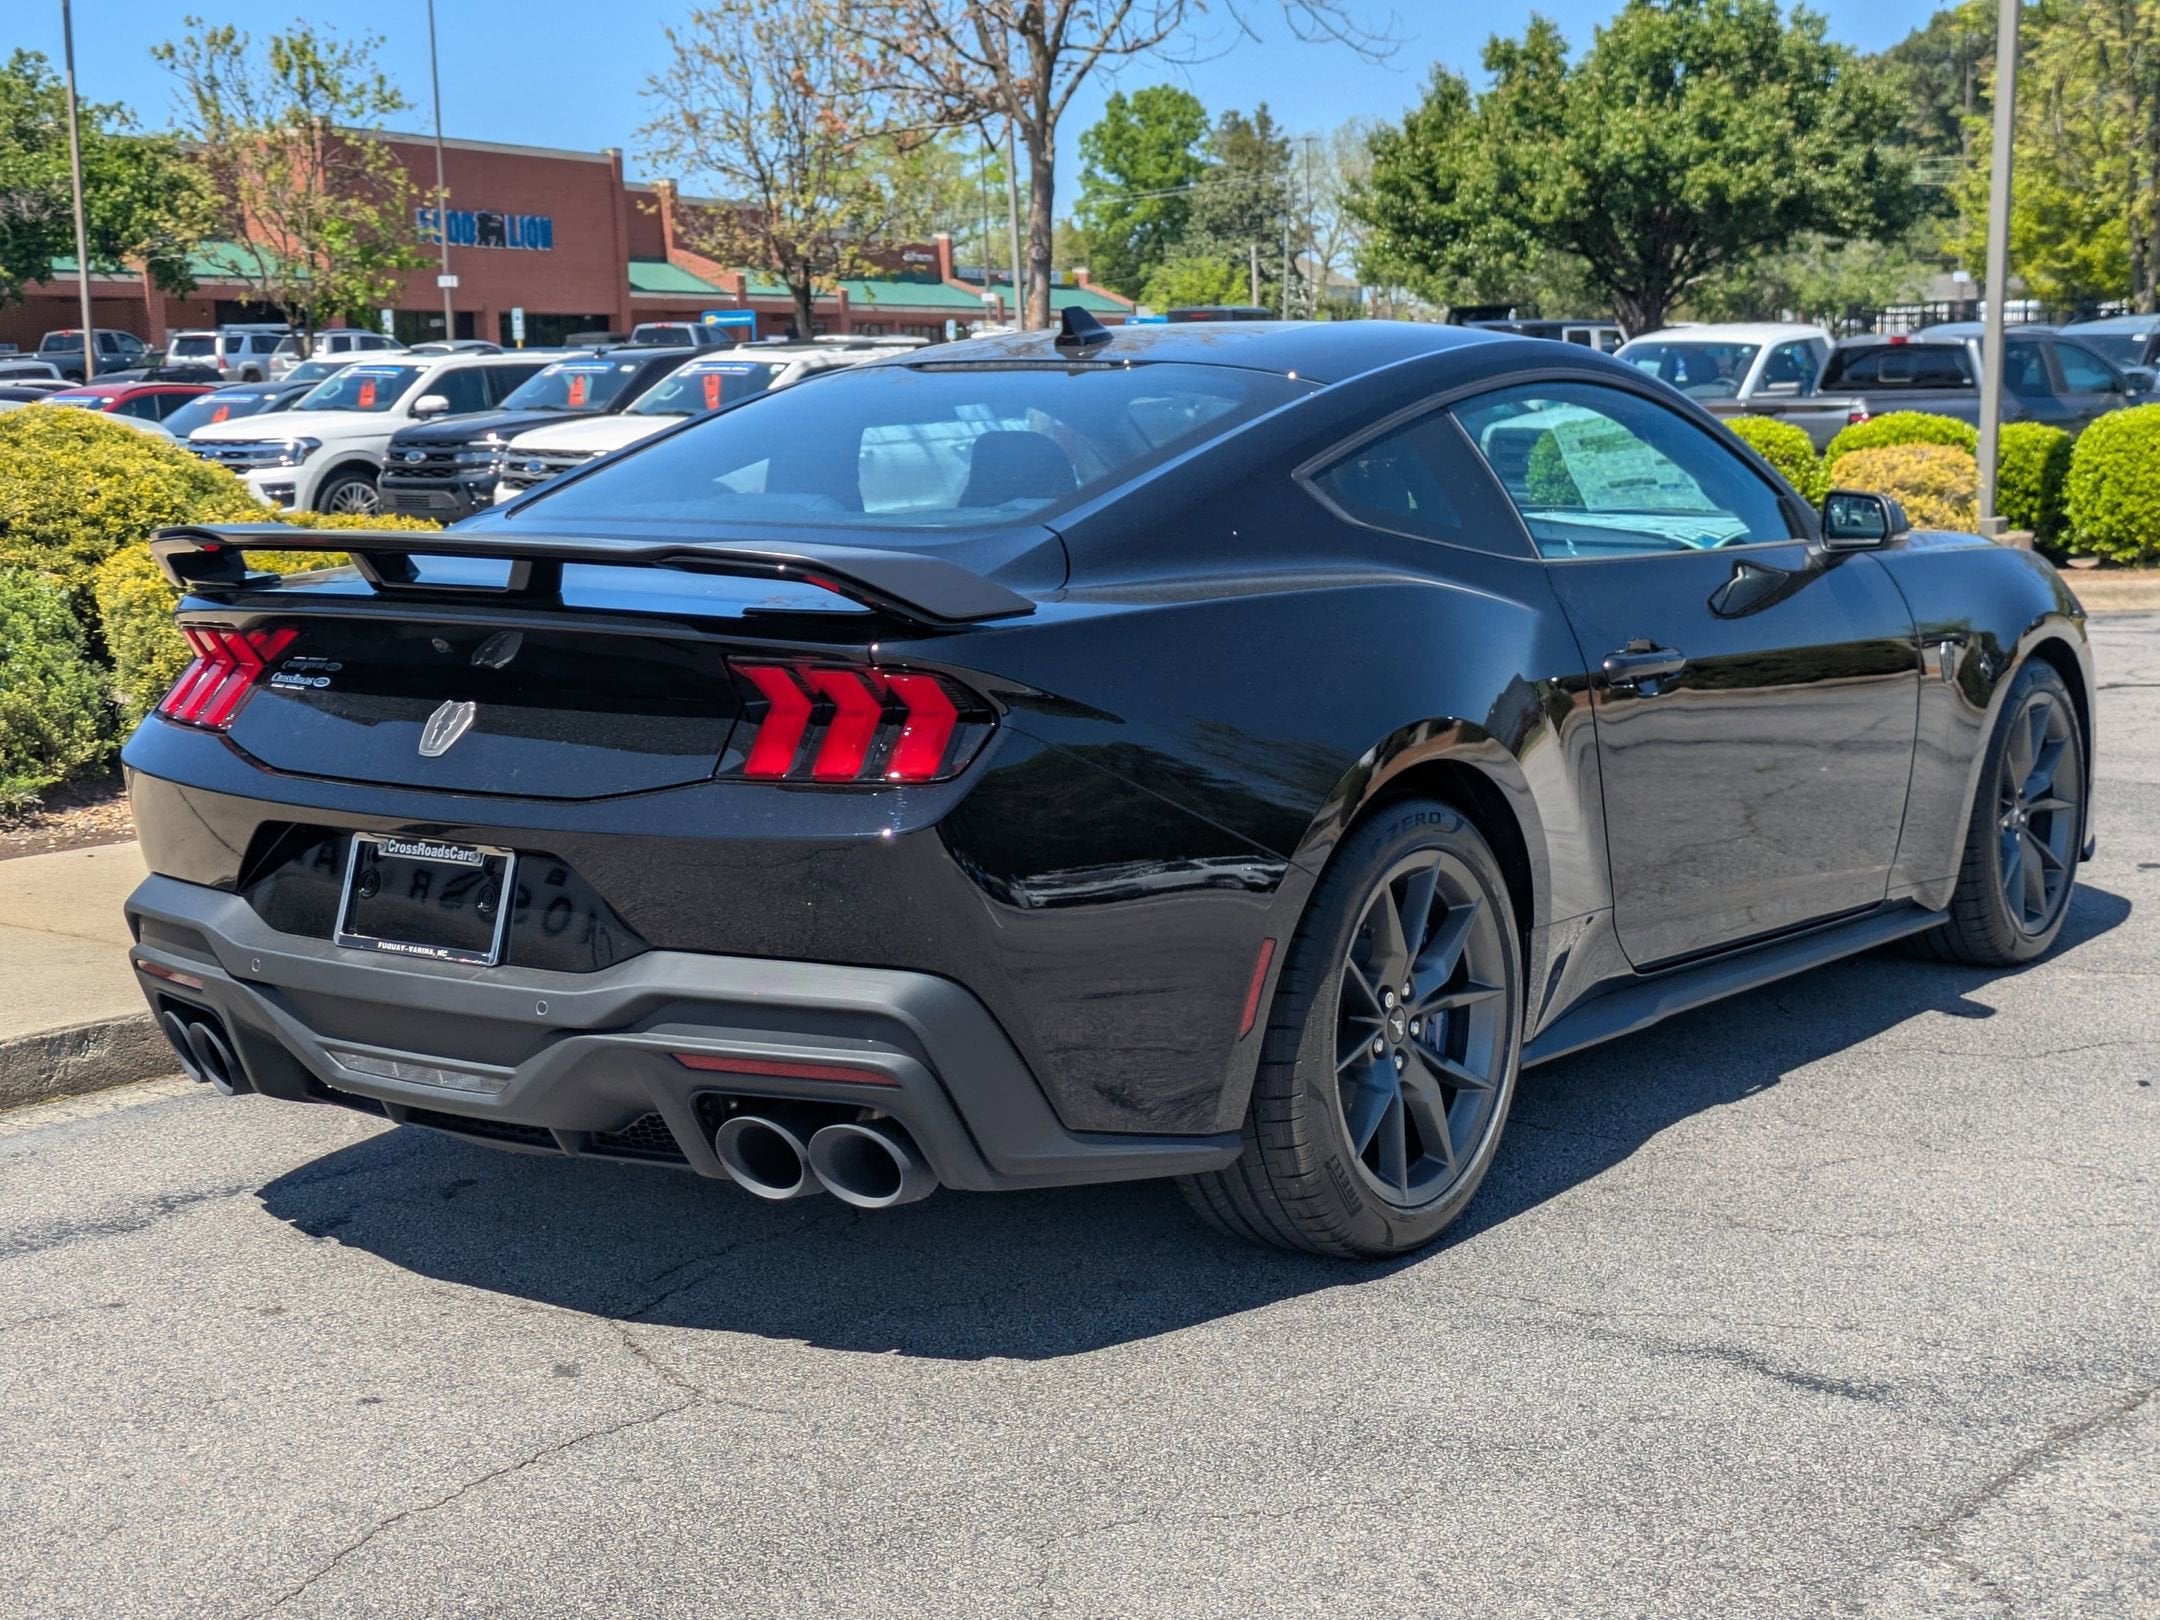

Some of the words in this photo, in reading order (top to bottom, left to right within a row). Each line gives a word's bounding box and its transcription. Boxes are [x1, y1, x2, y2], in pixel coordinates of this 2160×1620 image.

[504, 214, 553, 251] LION
[437, 949, 448, 958] NC
[1324, 1154, 1363, 1217] PIRELLI
